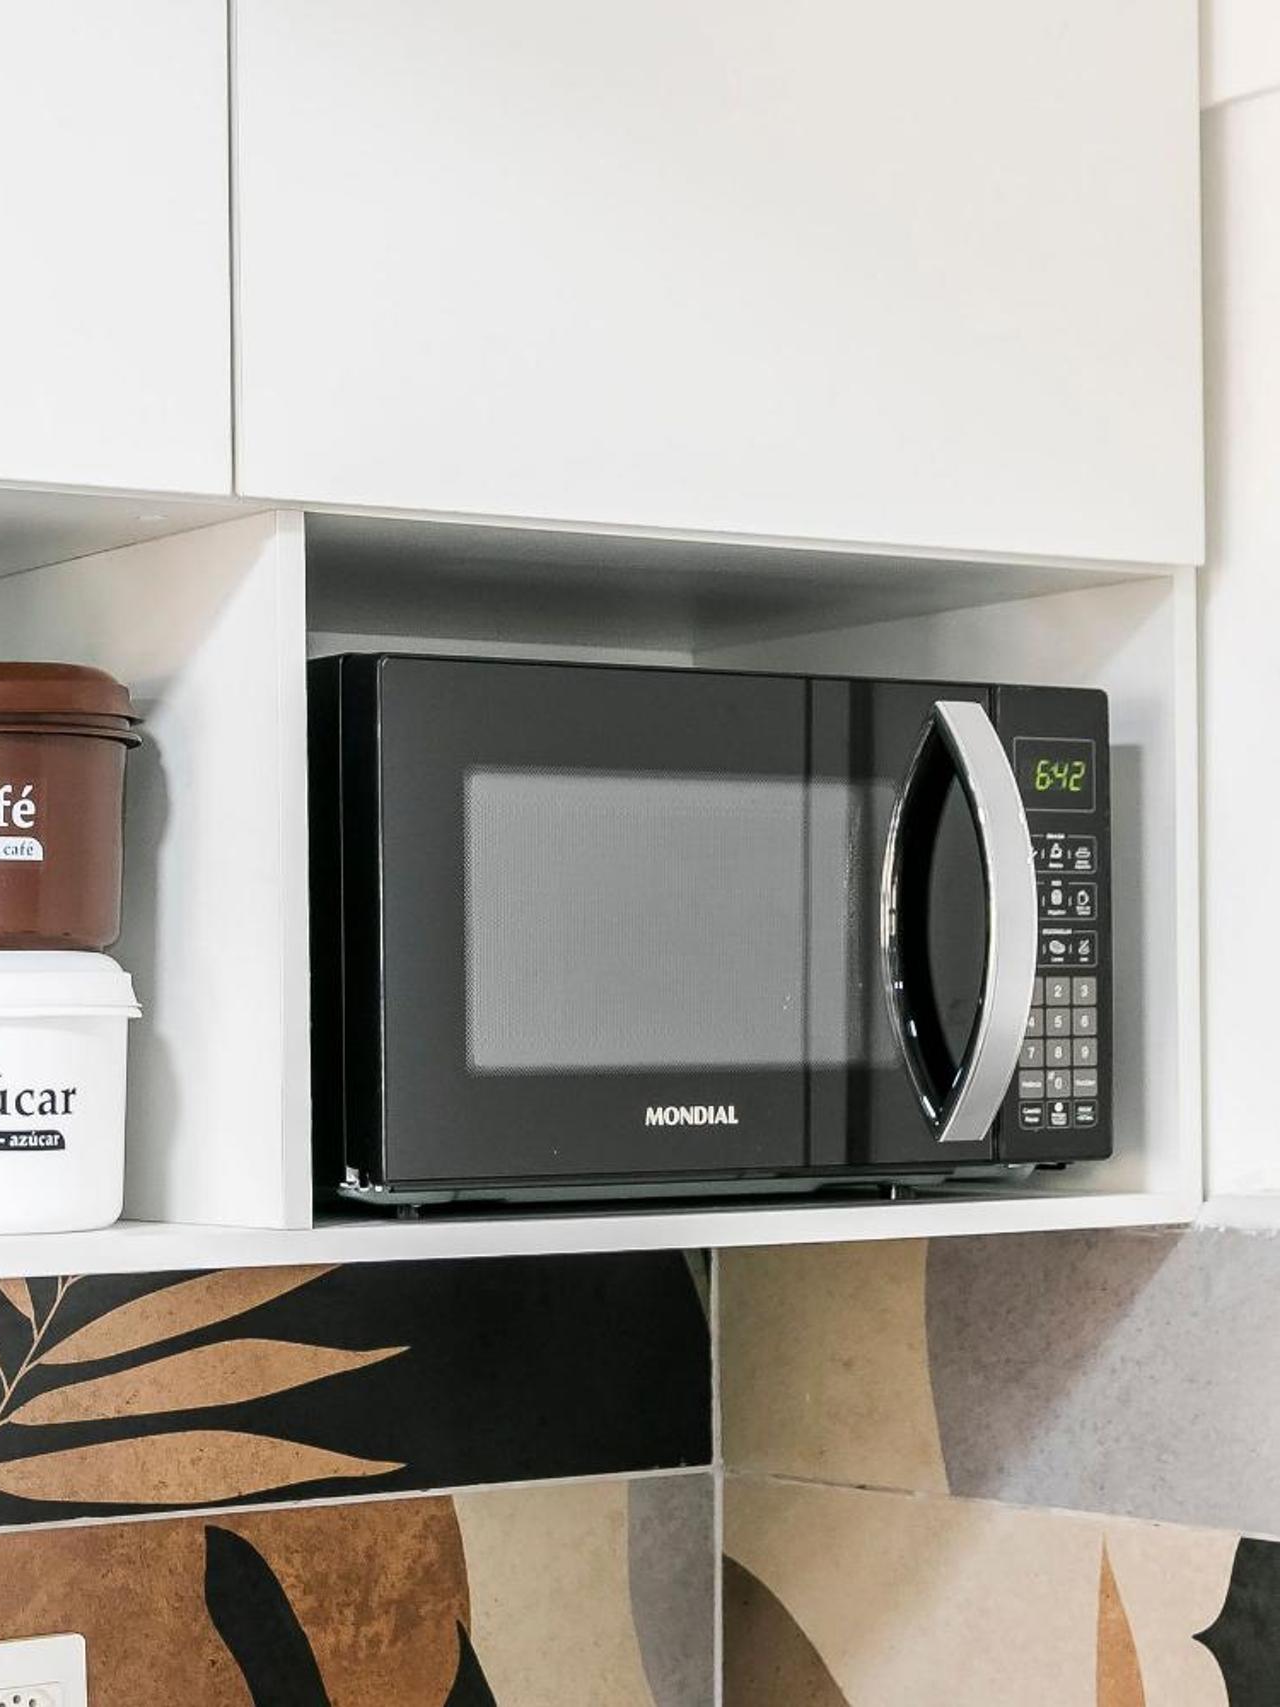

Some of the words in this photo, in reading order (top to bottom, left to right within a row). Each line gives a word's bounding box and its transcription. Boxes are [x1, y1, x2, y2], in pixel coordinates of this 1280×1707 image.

[3, 841, 34, 856] café
[1053, 984, 1063, 998] 2
[1080, 984, 1089, 998] 3
[1053, 1015, 1063, 1028] 5
[1027, 1046, 1035, 1059] 7
[1053, 1046, 1063, 1059] 8
[1080, 1046, 1089, 1059] 9
[645, 1105, 739, 1126] MONDIAL
